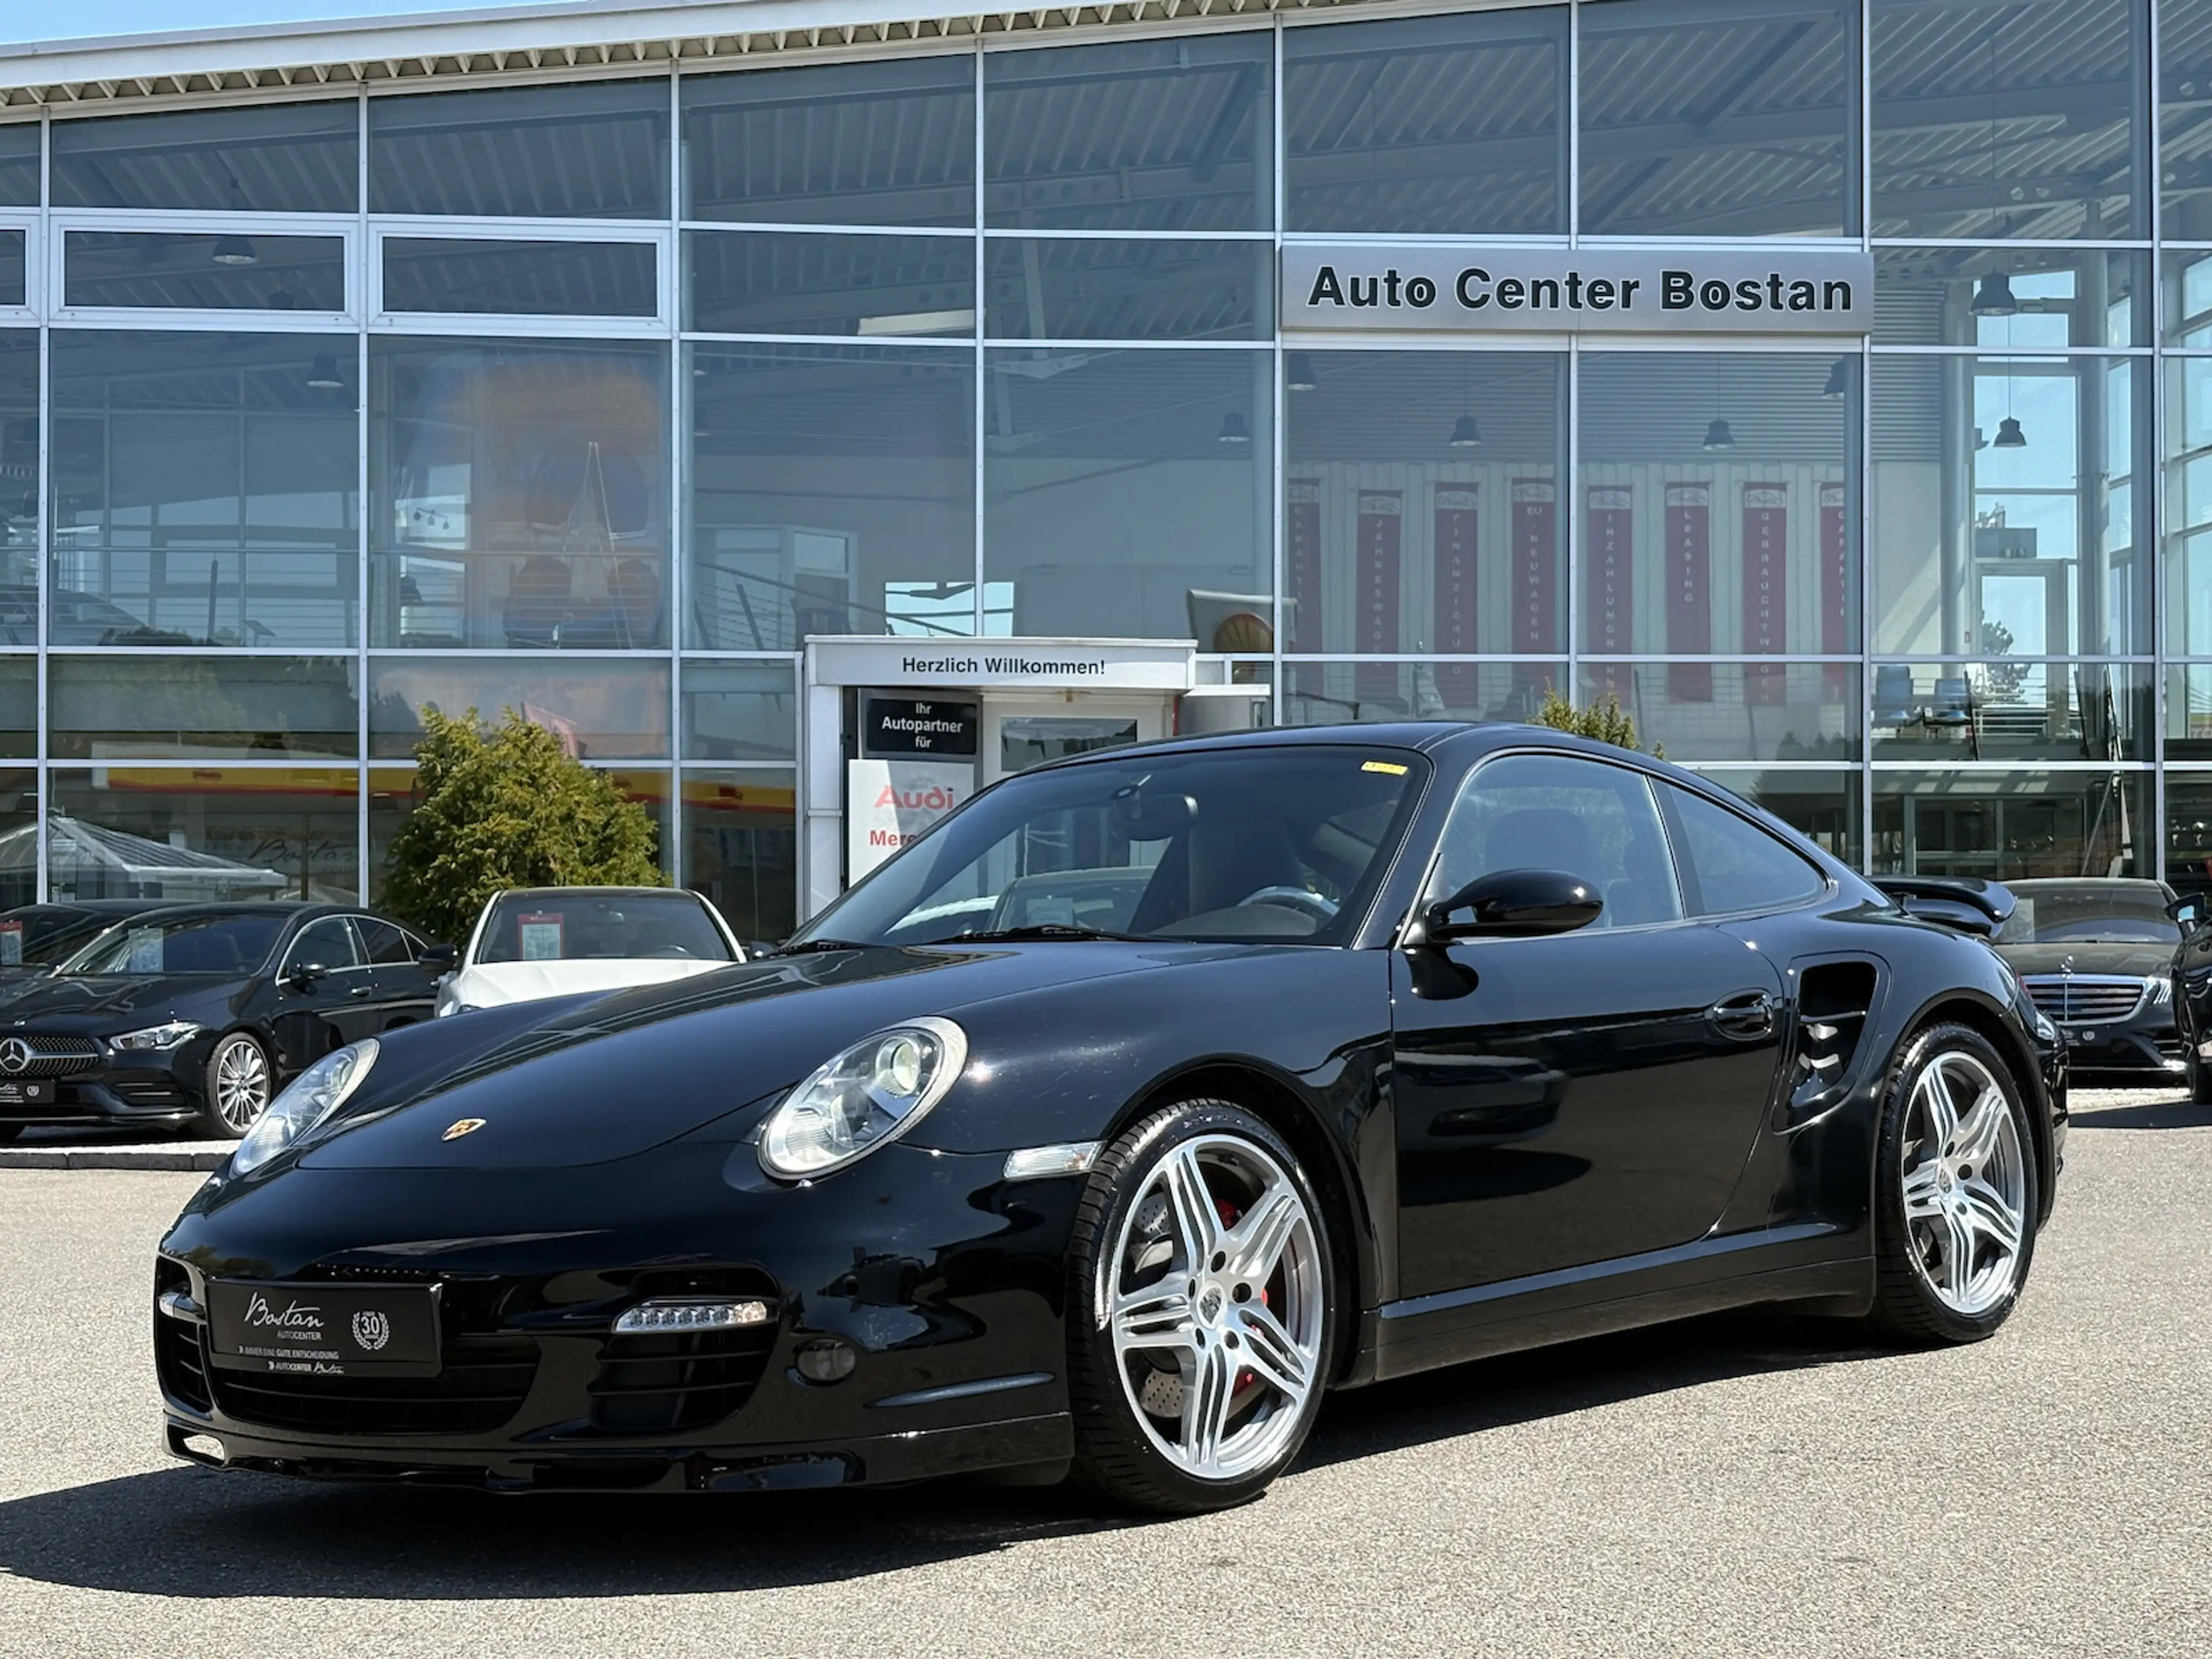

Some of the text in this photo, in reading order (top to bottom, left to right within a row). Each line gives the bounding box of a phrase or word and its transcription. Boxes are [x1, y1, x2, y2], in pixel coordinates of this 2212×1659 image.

[1306, 265, 1853, 312] Auto Center Bostan
[1684, 510, 1693, 603] LEASING
[1372, 519, 1384, 666] JAHRESWAGE
[1451, 514, 1461, 675] FINANZIERUG
[1759, 513, 1770, 702] GEBRAUCHTWGEN
[902, 657, 1105, 675] Herzlich Willkommen!
[915, 702, 932, 714] Ihr
[881, 715, 963, 733] Autopartner
[915, 736, 932, 748] für
[874, 785, 955, 810] Audi
[244, 1291, 325, 1328] Bostan
[361, 1316, 380, 1334] 30
